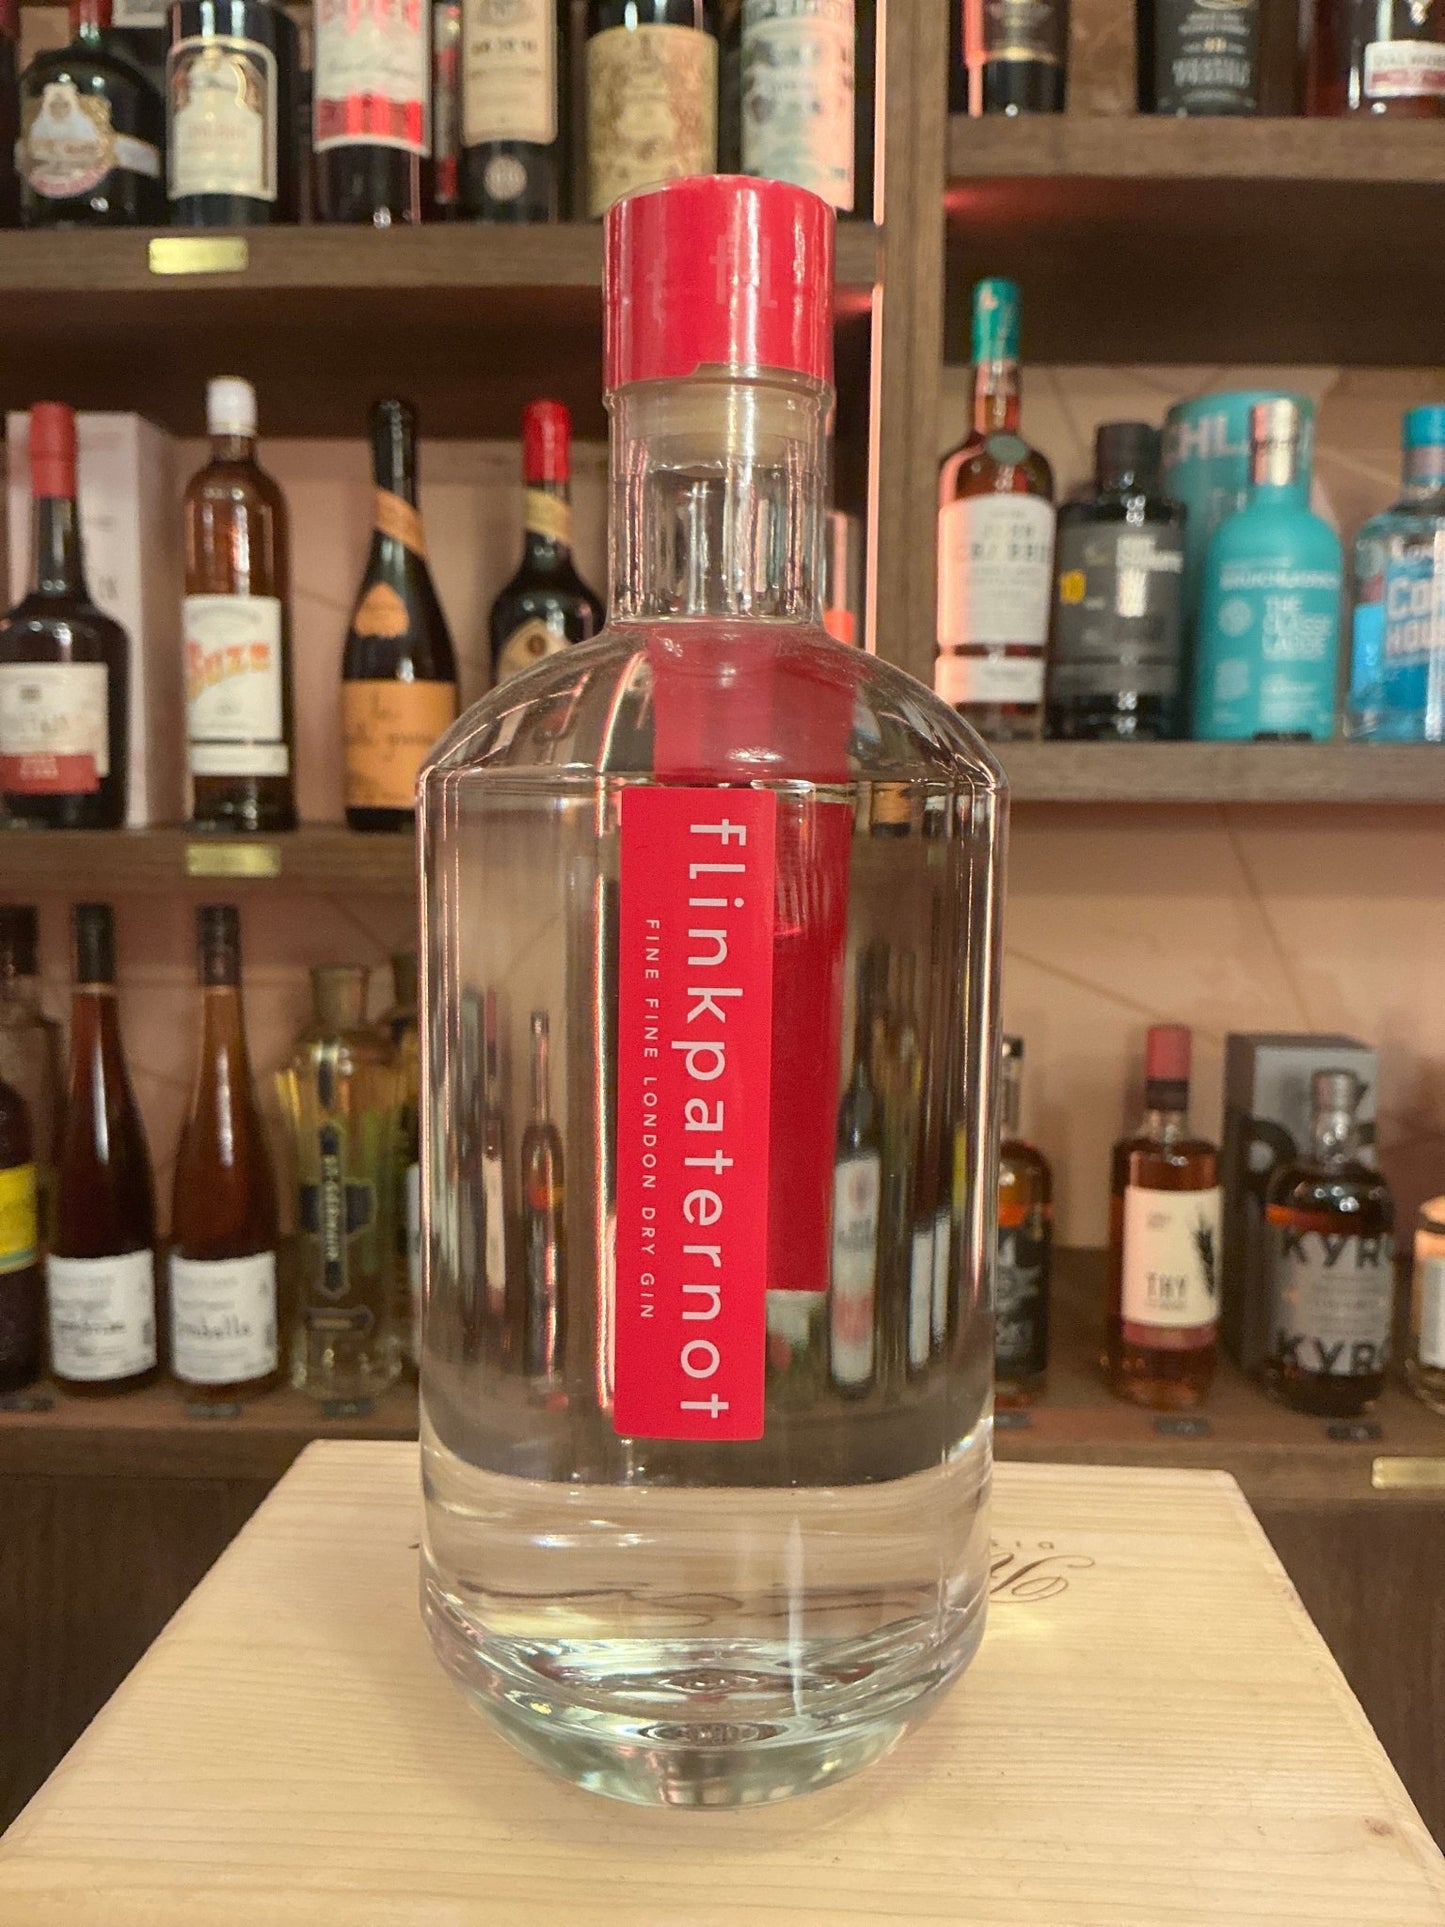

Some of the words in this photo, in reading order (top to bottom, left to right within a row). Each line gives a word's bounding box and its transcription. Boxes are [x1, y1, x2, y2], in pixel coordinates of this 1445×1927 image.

[645, 919, 660, 979] FINE
[644, 998, 659, 1058] FINE
[642, 1077, 657, 1188] LONDON
[671, 818, 746, 1418] flinkpaternot
[641, 1207, 656, 1255] DRY
[640, 1272, 655, 1318] GIN
